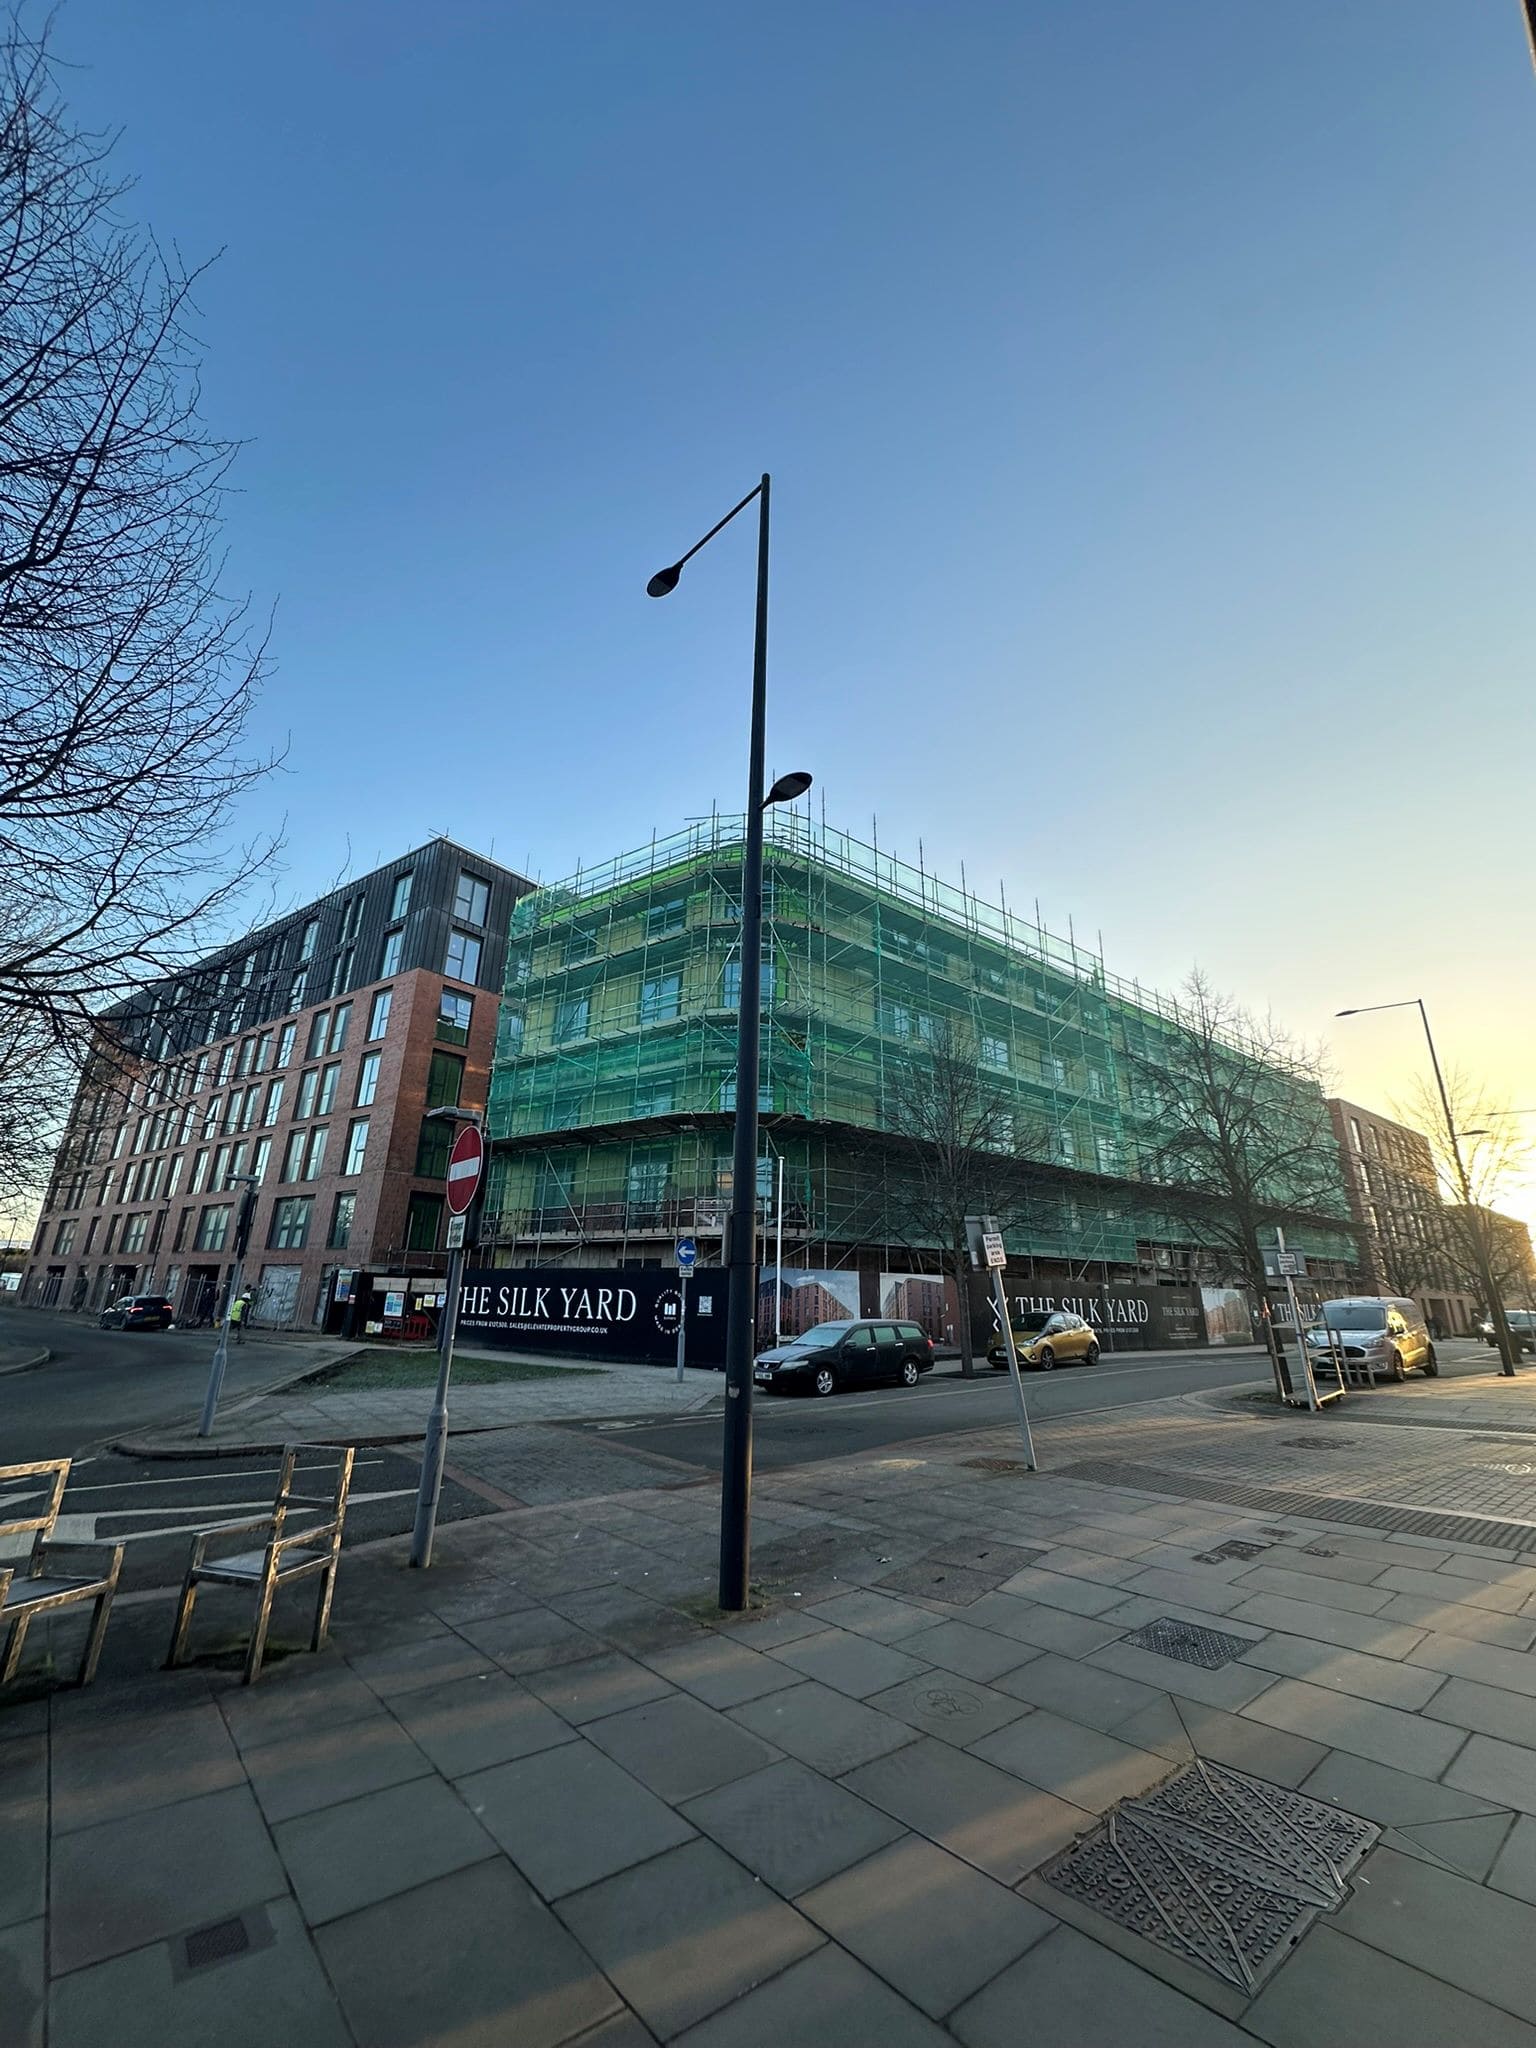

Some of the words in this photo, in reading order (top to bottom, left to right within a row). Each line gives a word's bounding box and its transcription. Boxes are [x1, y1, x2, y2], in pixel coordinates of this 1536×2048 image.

[460, 1286, 492, 1315] HE
[497, 1286, 551, 1319] SILK
[560, 1287, 637, 1322] YARD
[1061, 1297, 1103, 1324] SILK
[1106, 1299, 1149, 1324] YARD
[1161, 1306, 1173, 1317] THE
[1173, 1306, 1186, 1317] SILK
[1277, 1303, 1294, 1322] TH
